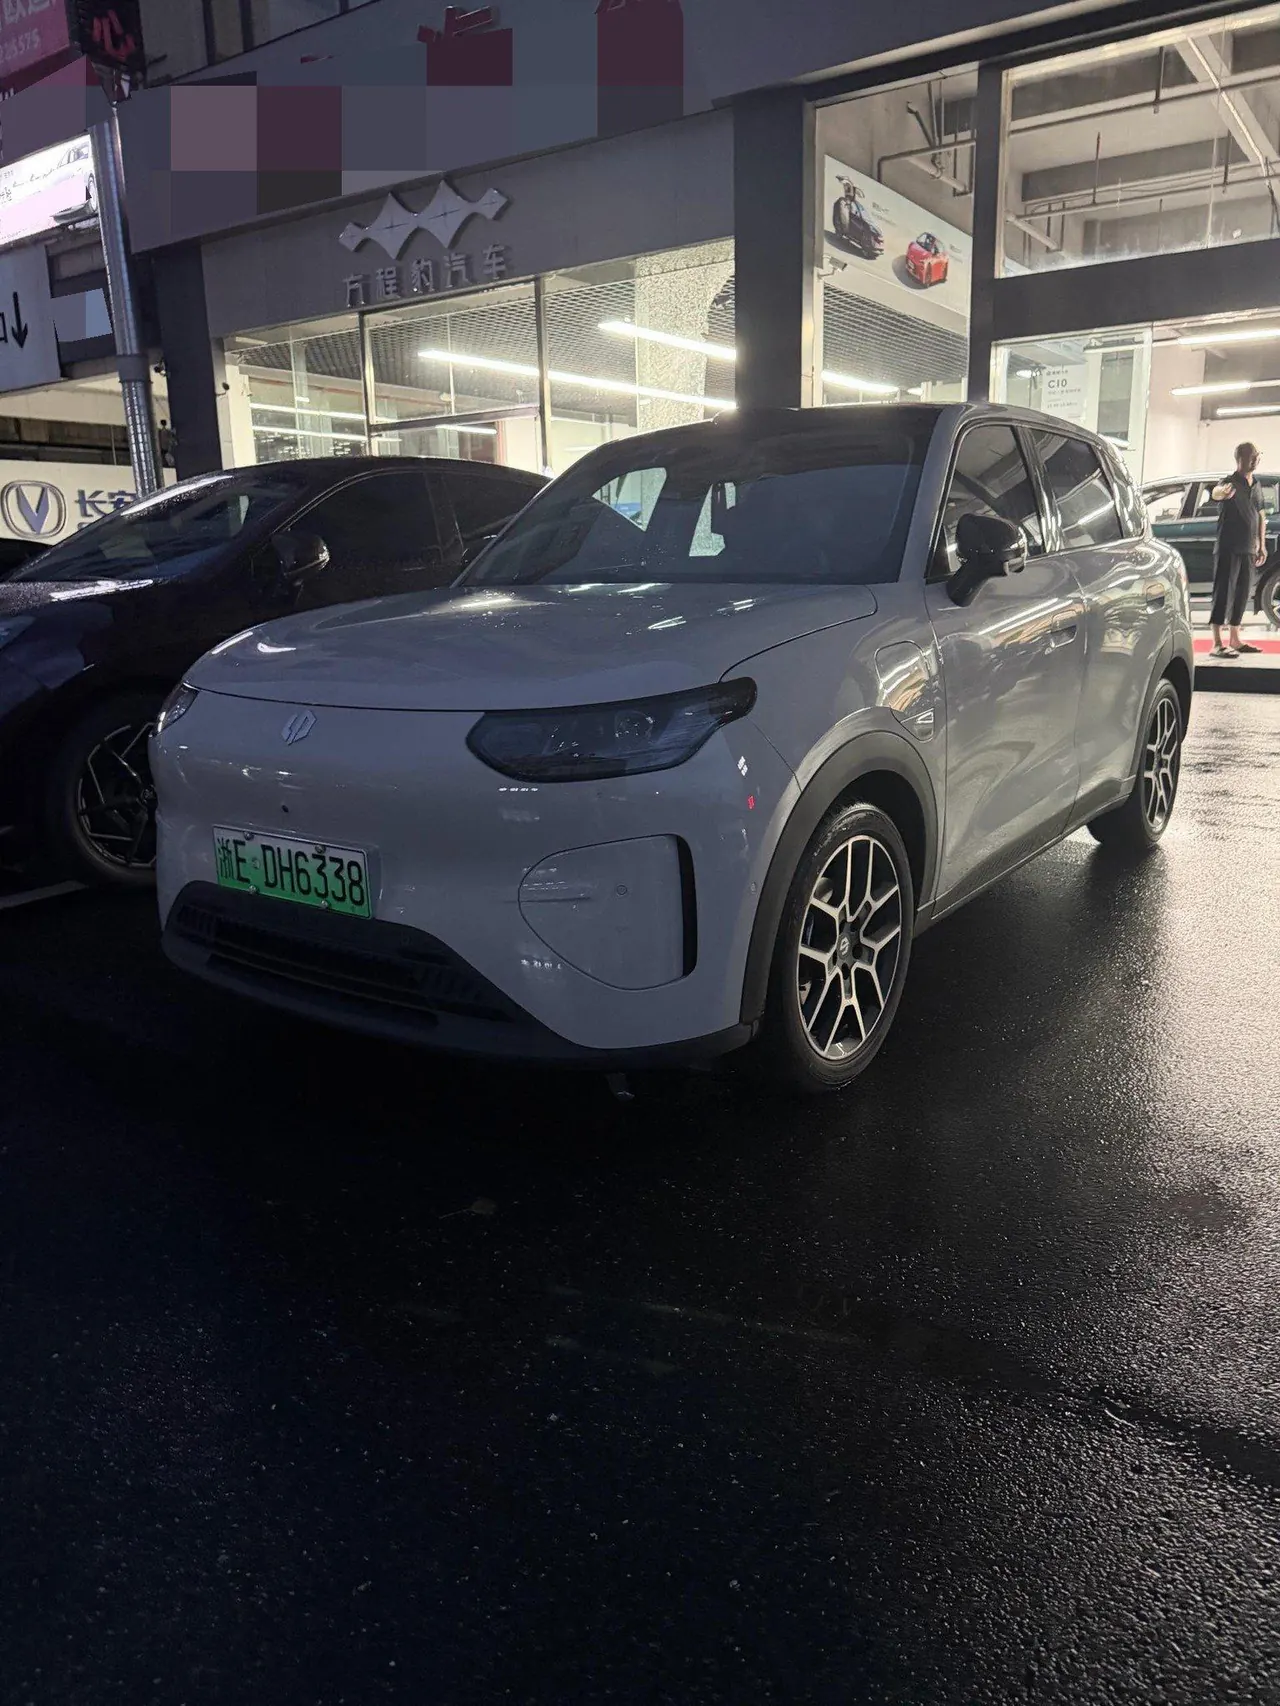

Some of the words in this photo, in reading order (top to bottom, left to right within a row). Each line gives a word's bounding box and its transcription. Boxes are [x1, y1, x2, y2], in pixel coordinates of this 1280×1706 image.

[342, 243, 507, 307] 方程豹汽车
[1047, 378, 1068, 389] C10
